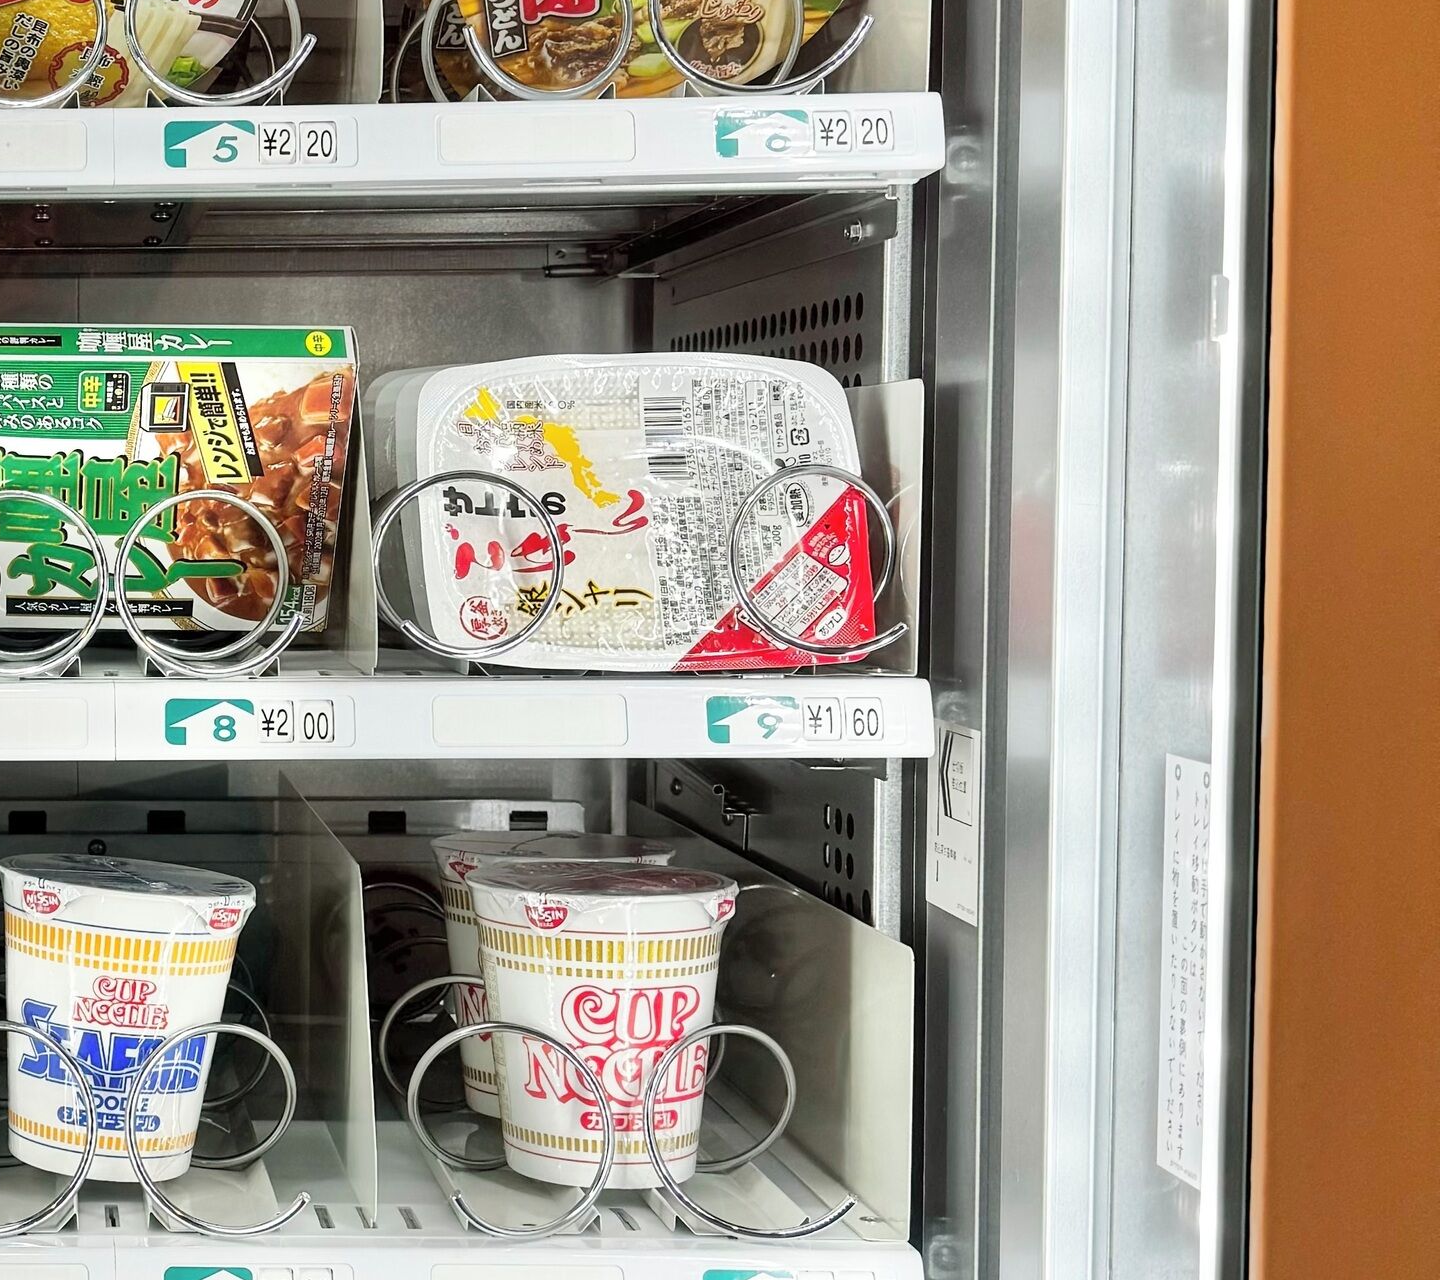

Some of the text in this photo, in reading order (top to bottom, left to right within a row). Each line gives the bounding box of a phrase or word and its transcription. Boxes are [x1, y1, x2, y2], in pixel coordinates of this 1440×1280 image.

[3, 18, 49, 90] 昆布の奥深い
[212, 135, 239, 163] 5
[81, 375, 103, 411] 中辛
[191, 371, 244, 480] レンジで簡単!!
[443, 488, 650, 580] ごはん
[8, 544, 248, 600] カレー
[212, 716, 240, 743] 8
[25, 892, 59, 908] NISSIN
[528, 906, 567, 924] NISSIN
[92, 975, 158, 1004] CUP
[560, 984, 701, 1046] CUP
